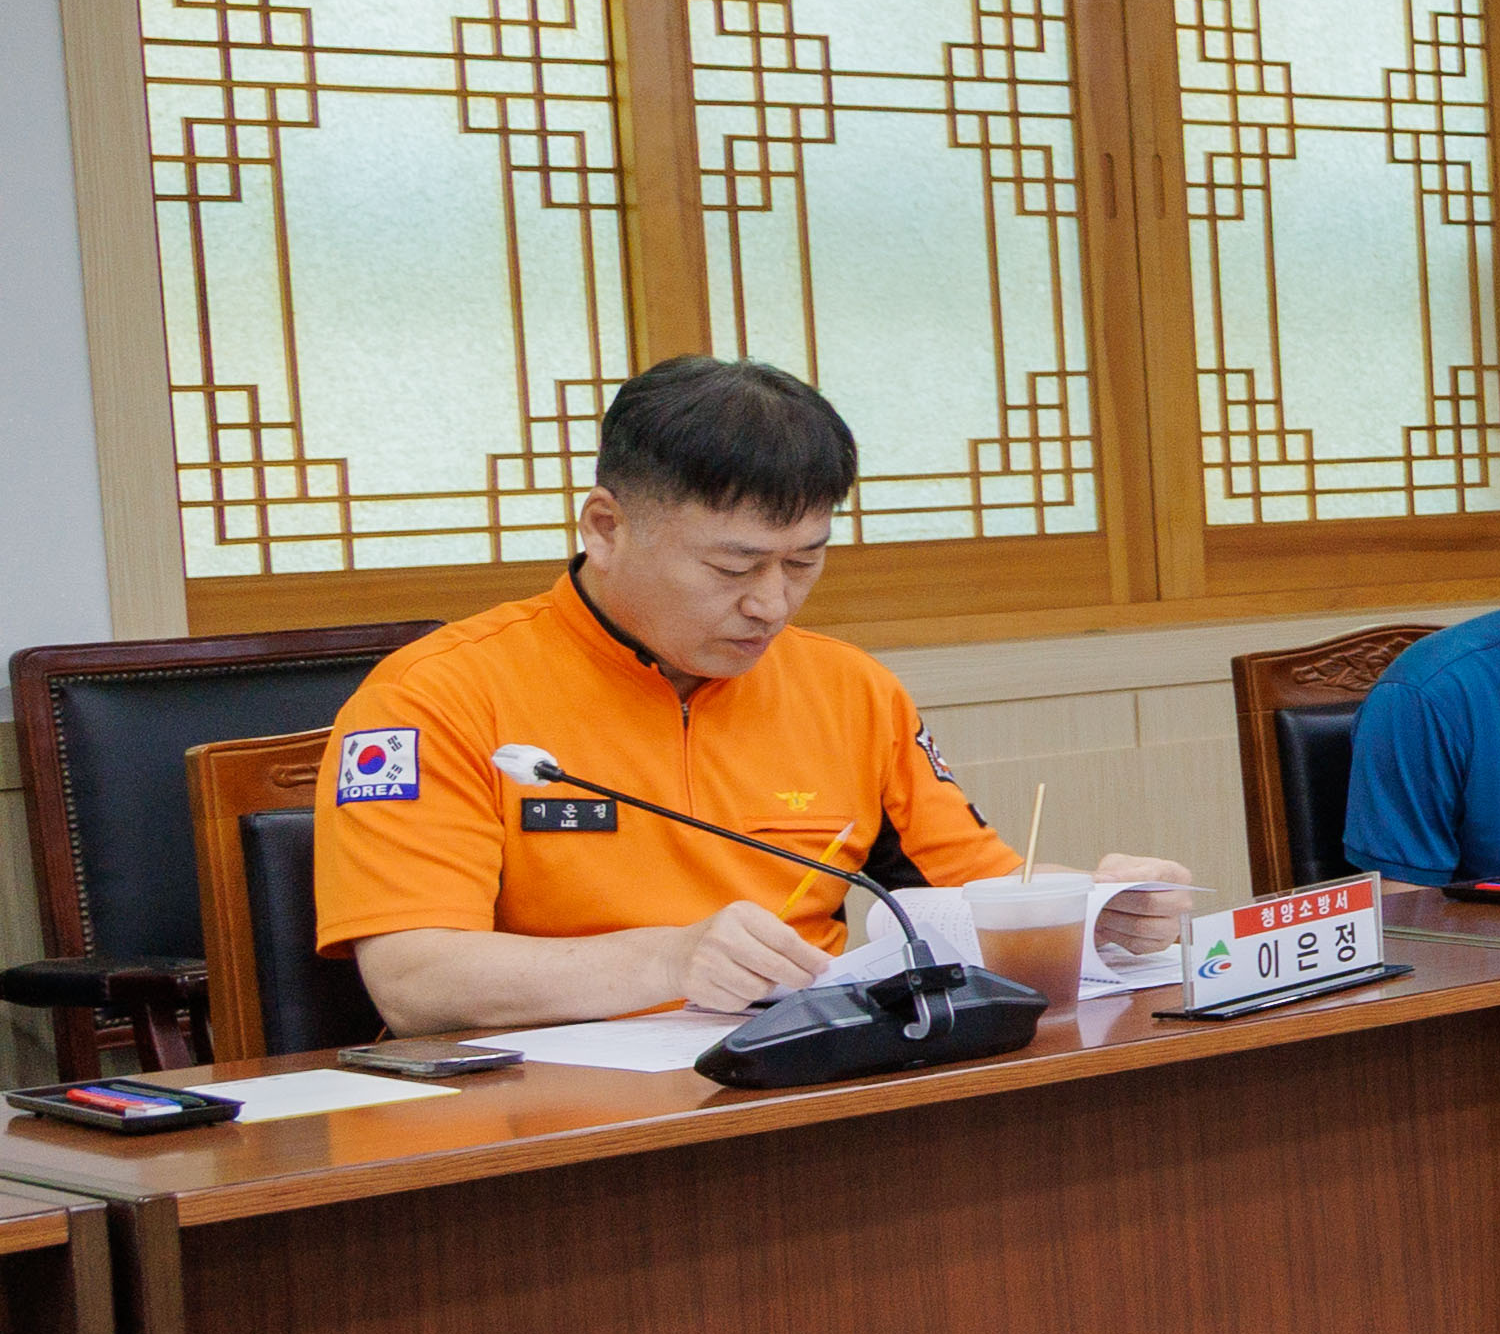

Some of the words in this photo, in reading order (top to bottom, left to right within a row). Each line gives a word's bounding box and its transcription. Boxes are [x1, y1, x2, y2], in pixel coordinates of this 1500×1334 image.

[342, 784, 403, 799] KOREA
[1261, 890, 1348, 928] 청양소방서
[1258, 922, 1357, 978] 이은정
